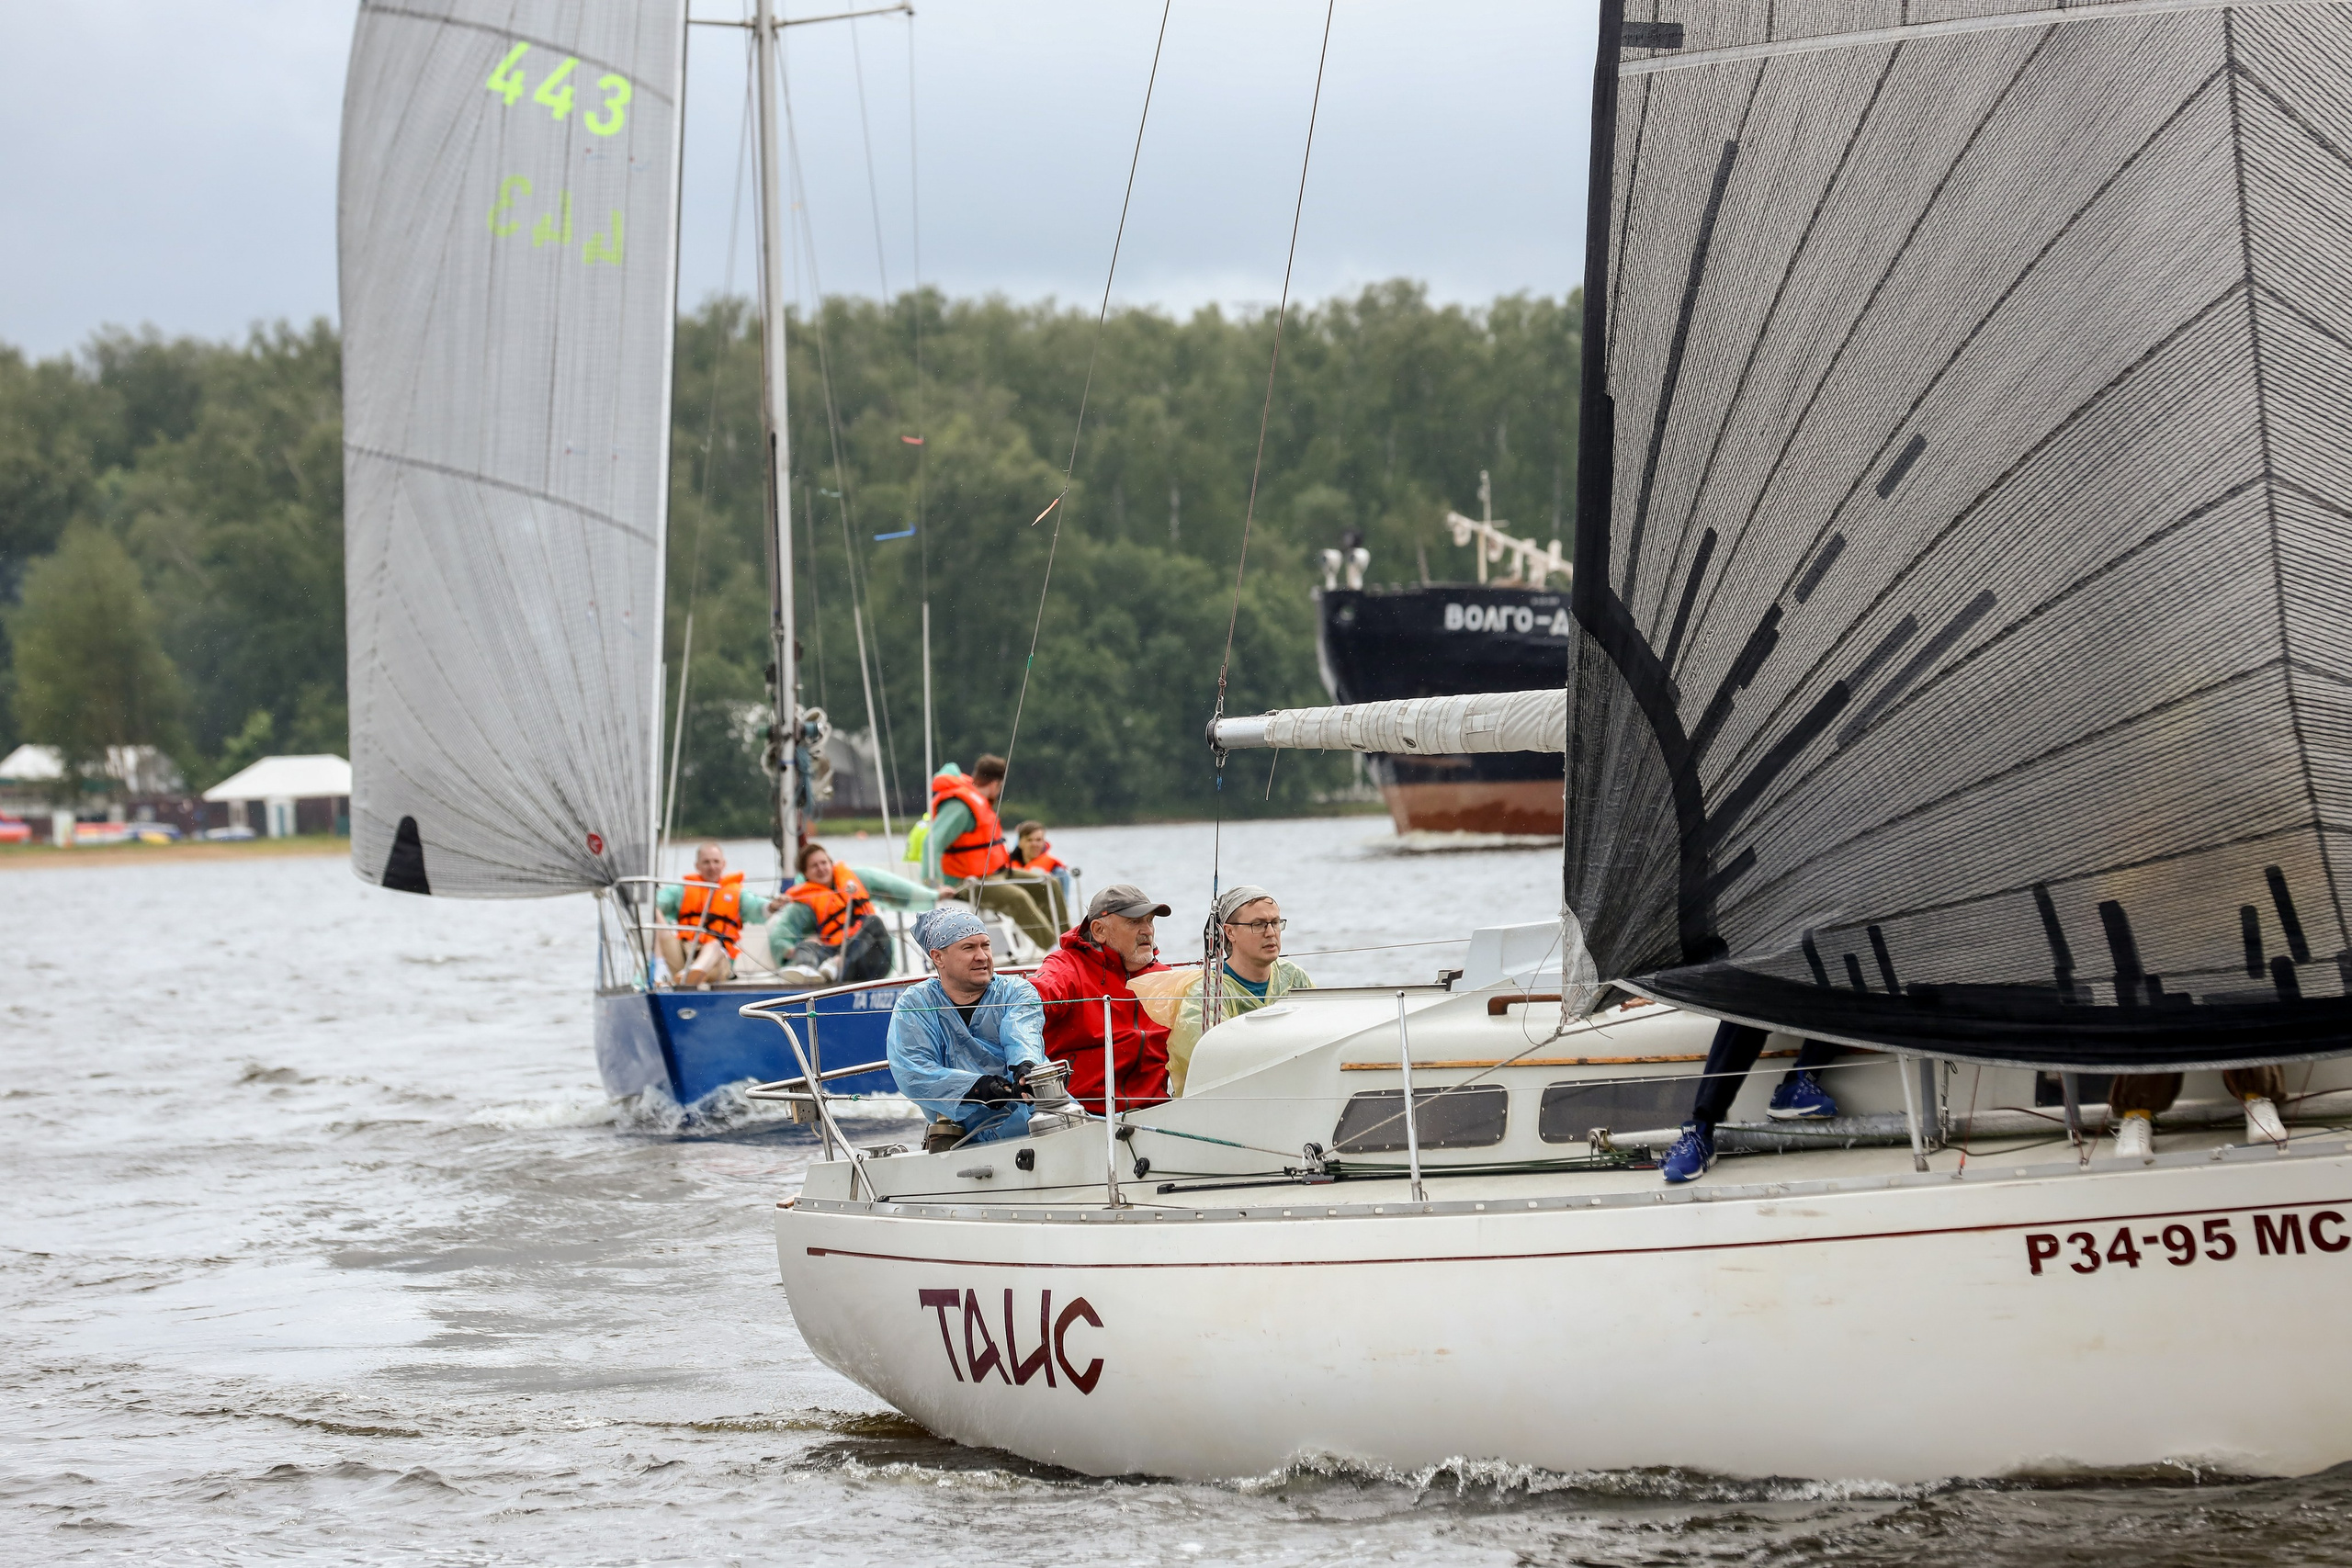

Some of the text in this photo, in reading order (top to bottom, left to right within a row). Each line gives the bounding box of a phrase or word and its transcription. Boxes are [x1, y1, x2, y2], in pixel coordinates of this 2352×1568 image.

[486, 41, 632, 137] 443
[2026, 1211, 2351, 1276] Р34-95 МС
